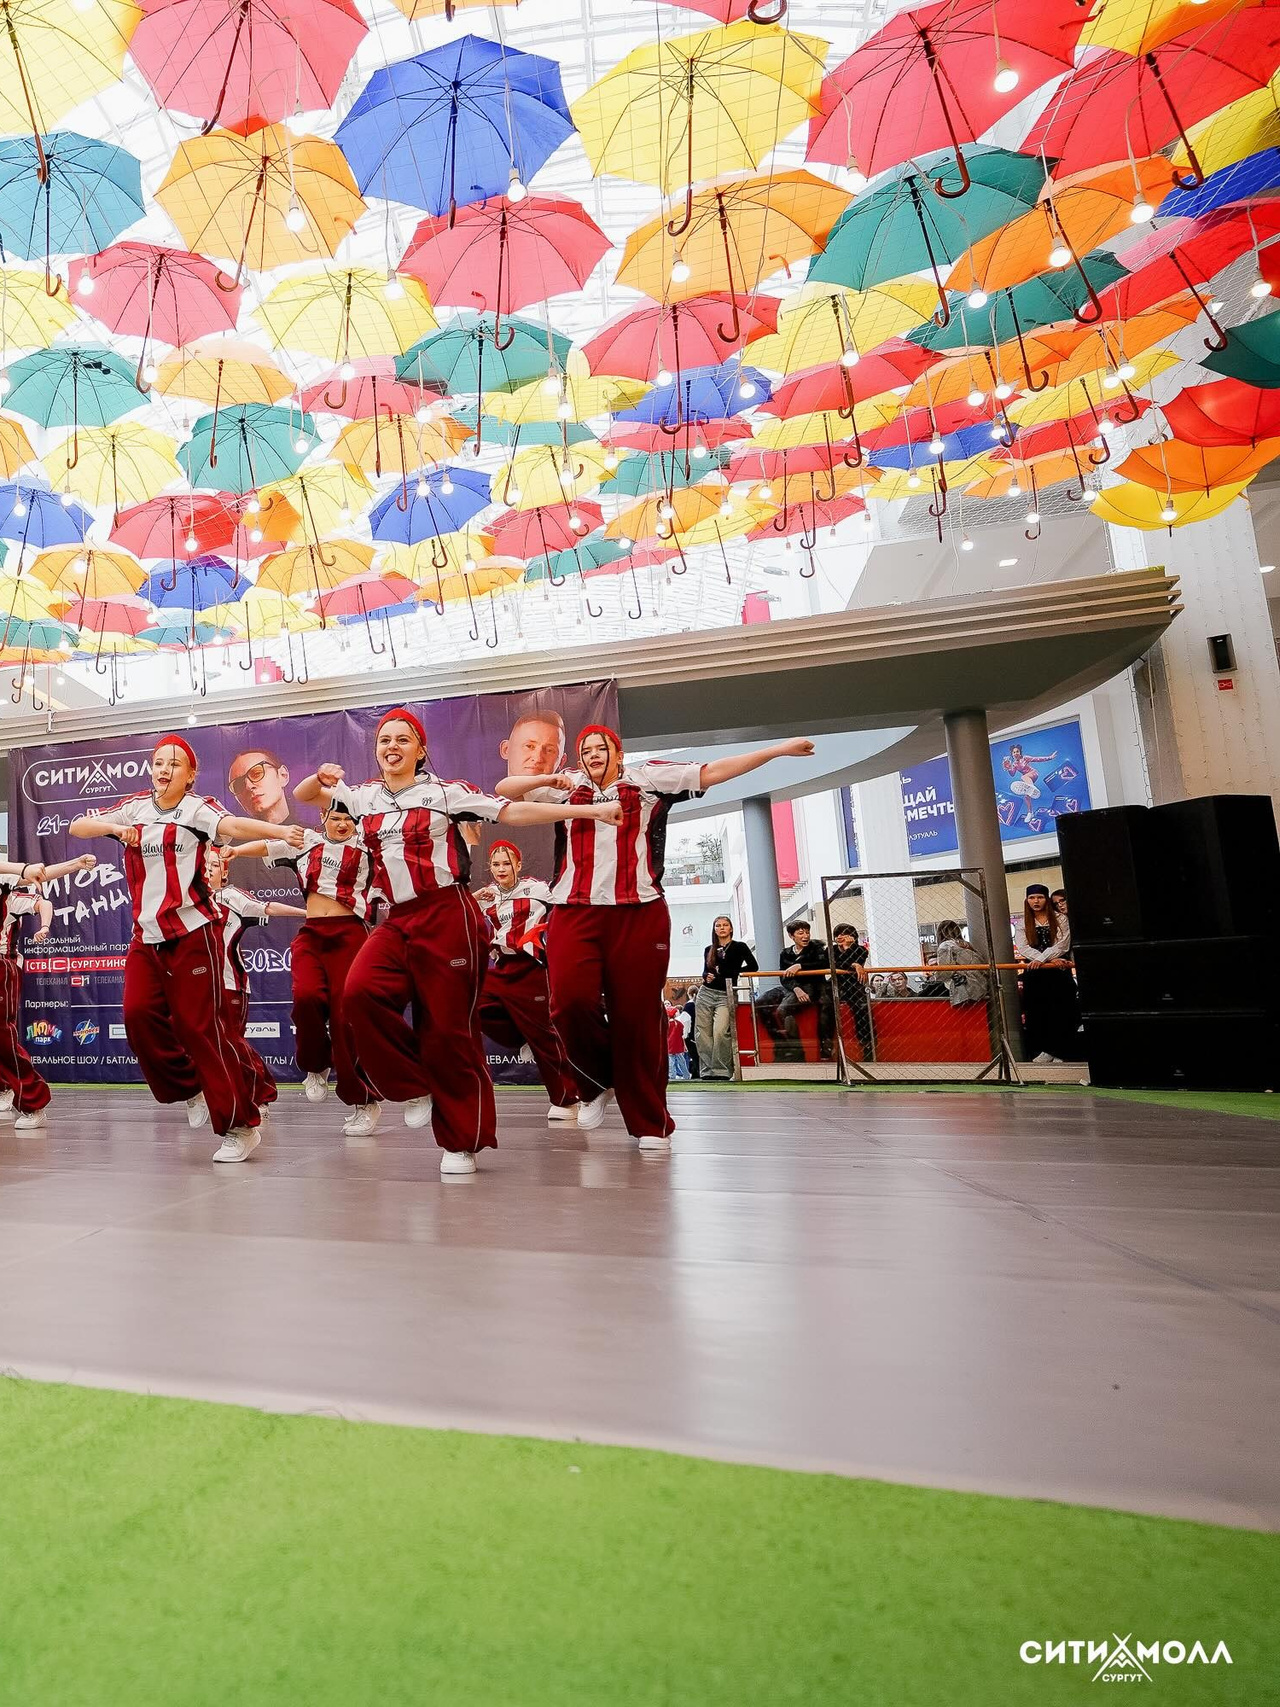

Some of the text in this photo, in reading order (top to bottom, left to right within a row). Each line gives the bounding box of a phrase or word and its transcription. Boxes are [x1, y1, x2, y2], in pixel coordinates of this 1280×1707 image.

[35, 766, 89, 786] СИТИ
[257, 887, 302, 898] СОКОЛО
[24, 934, 81, 946] Геральный
[24, 943, 108, 955] информационный
[25, 1000, 69, 1009] Партнеры:
[77, 1055, 99, 1065] ШОУ
[106, 1055, 139, 1065] БАТТЛЫ
